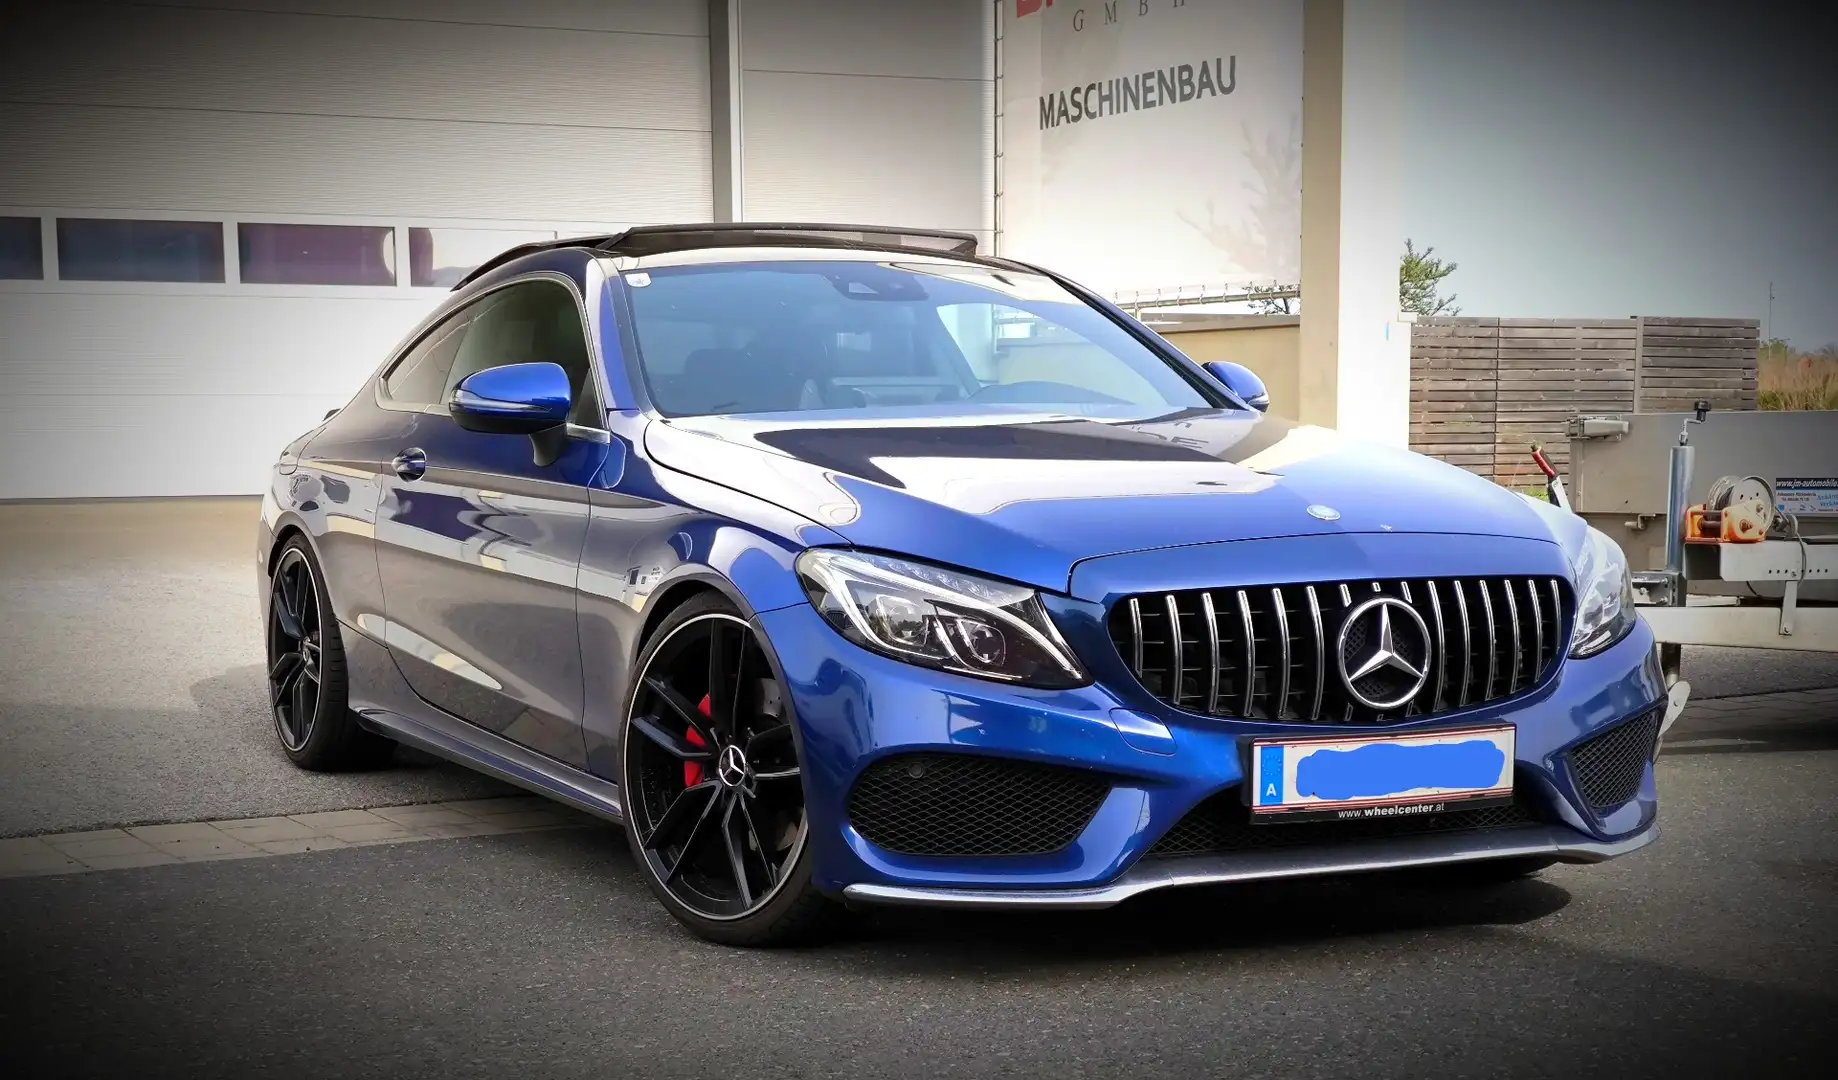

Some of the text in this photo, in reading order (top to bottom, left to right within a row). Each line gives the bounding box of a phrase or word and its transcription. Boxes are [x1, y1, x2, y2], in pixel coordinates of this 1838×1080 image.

[1039, 55, 1236, 130] MASCHINENBAU
[1266, 783, 1277, 796] A
[1338, 802, 1445, 819] www.wheelcenter.at
